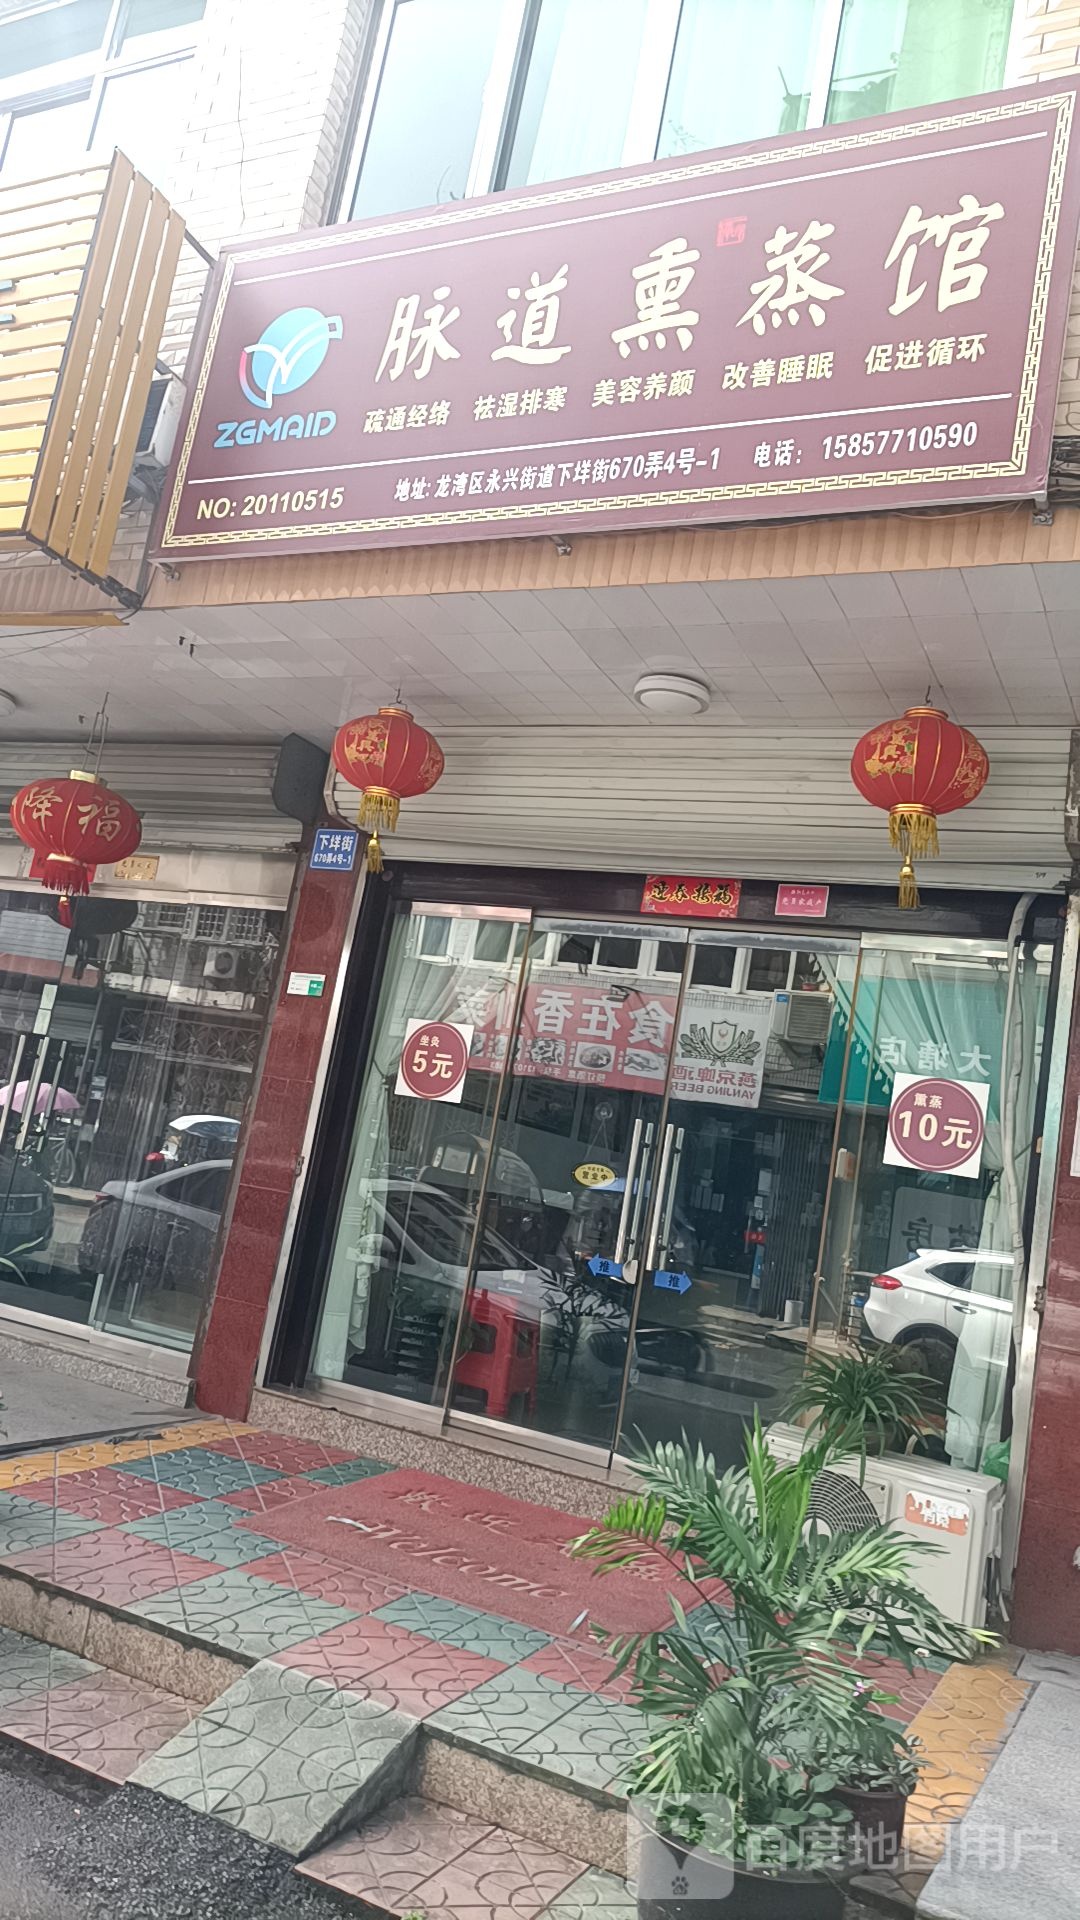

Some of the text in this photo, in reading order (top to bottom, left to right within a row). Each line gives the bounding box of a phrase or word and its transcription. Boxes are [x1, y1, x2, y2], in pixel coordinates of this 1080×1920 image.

[374, 194, 1005, 384] 脉道熏蒸馆
[361, 399, 452, 434] 疏通经络
[590, 369, 696, 408] 美容养颜
[720, 351, 835, 391] 改善睡眠
[864, 333, 988, 375] 促进循环
[213, 409, 337, 448] ZGMAID
[821, 420, 979, 460] 15857710590
[196, 487, 345, 520] NO: 20110515
[313, 852, 352, 865] 670弄4号-1
[319, 834, 355, 852] 下垟街
[411, 1048, 454, 1079] 5元
[898, 1110, 974, 1150] 10元
[598, 1260, 610, 1273] 推
[667, 1274, 681, 1288] 推
